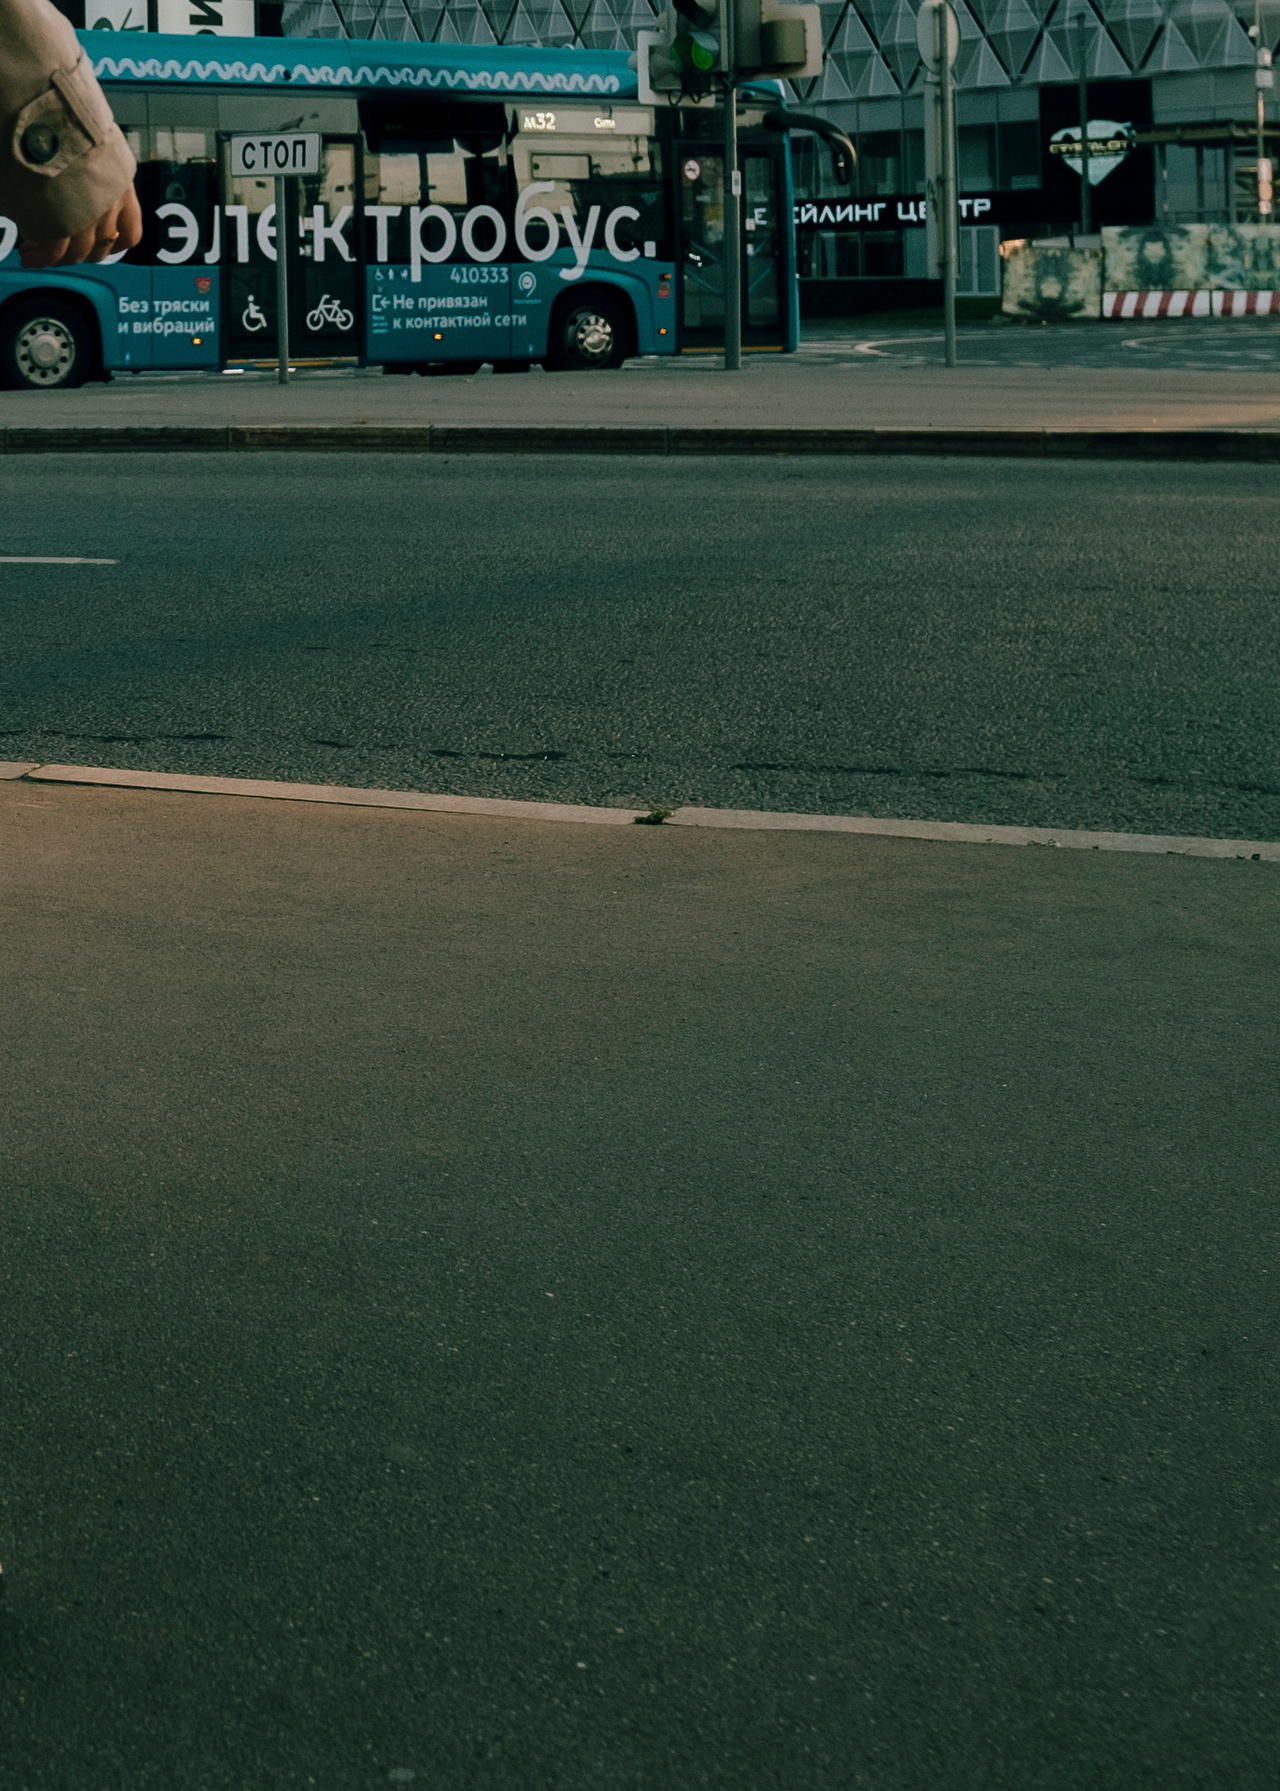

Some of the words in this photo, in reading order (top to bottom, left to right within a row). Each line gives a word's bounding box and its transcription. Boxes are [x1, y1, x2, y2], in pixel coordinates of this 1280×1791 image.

[242, 140, 306, 170] СТОП
[897, 199, 991, 223] ЦЕТР
[450, 267, 509, 284] 410333
[119, 297, 148, 313] Без
[154, 300, 209, 316] тряски
[393, 294, 414, 310] Не
[418, 296, 487, 312] привязан
[118, 322, 128, 334] и
[132, 317, 214, 336] вибраций
[393, 318, 402, 329] к
[406, 312, 490, 329] контактной
[494, 315, 527, 327] сети
